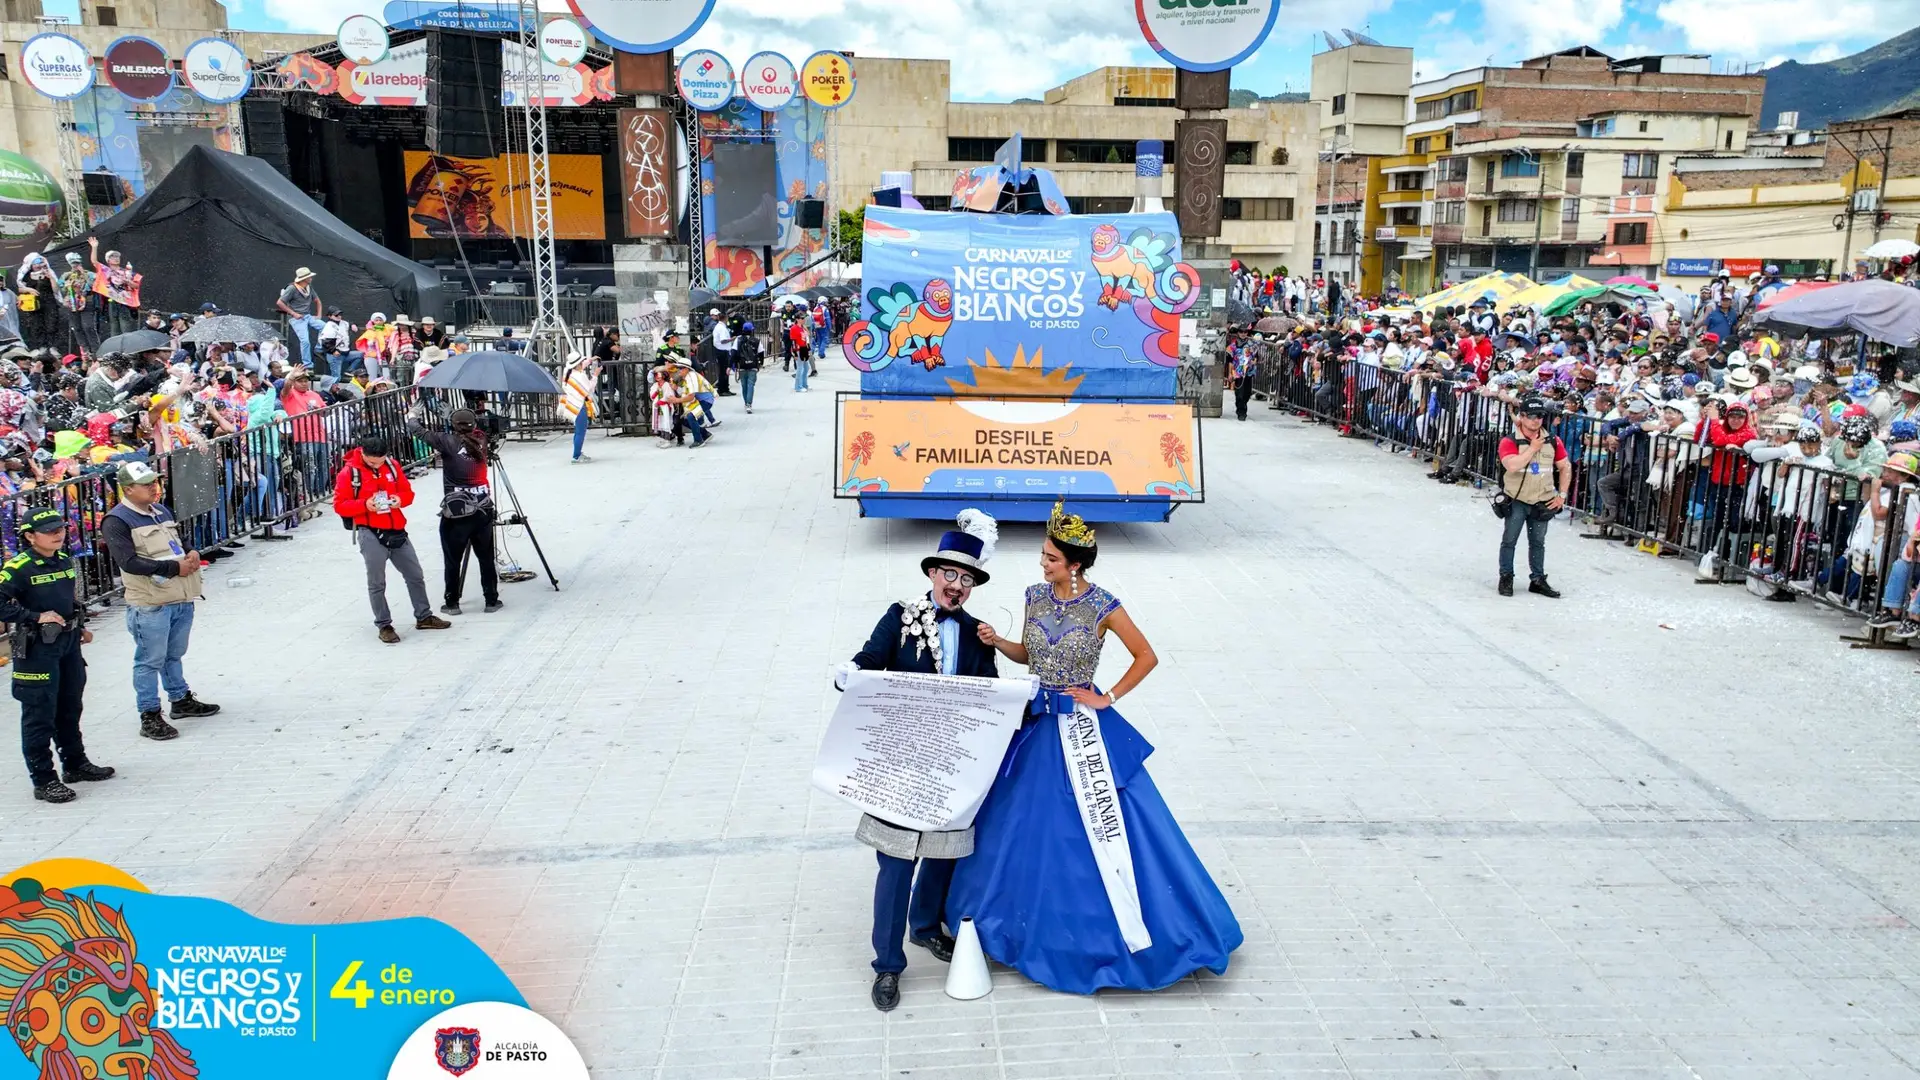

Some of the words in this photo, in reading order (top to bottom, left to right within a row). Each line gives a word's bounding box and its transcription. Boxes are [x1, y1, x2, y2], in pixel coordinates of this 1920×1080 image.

[1155, 12, 1184, 20] alquiler,
[1223, 8, 1260, 17] transporte
[1206, 17, 1236, 25] nacional
[38, 64, 82, 73] SUPERGAS
[112, 65, 166, 74] BAILEMOS
[192, 72, 241, 82] SuperGiros
[811, 76, 845, 85] POKER
[683, 79, 728, 89] Domino's
[749, 85, 791, 95] VEOLIA
[693, 89, 719, 99] Pizza
[964, 248, 1069, 264] CARNAVAL
[1057, 250, 1073, 259] DE
[952, 266, 1067, 293] NEGROS
[954, 291, 1085, 322] BLANCOS
[1030, 320, 1043, 329] DE
[1046, 320, 1080, 330] PASTO
[975, 430, 1053, 446] DESFILE
[916, 448, 994, 464] FAMILIA
[998, 446, 1113, 466] CASTAÑEDA
[1067, 723, 1081, 750] Negros
[1086, 753, 1105, 778] DEL
[1077, 761, 1090, 789] Blancos
[1084, 792, 1094, 801] de
[1087, 803, 1098, 824] Pasto
[1092, 779, 1121, 842] CARNAVAL
